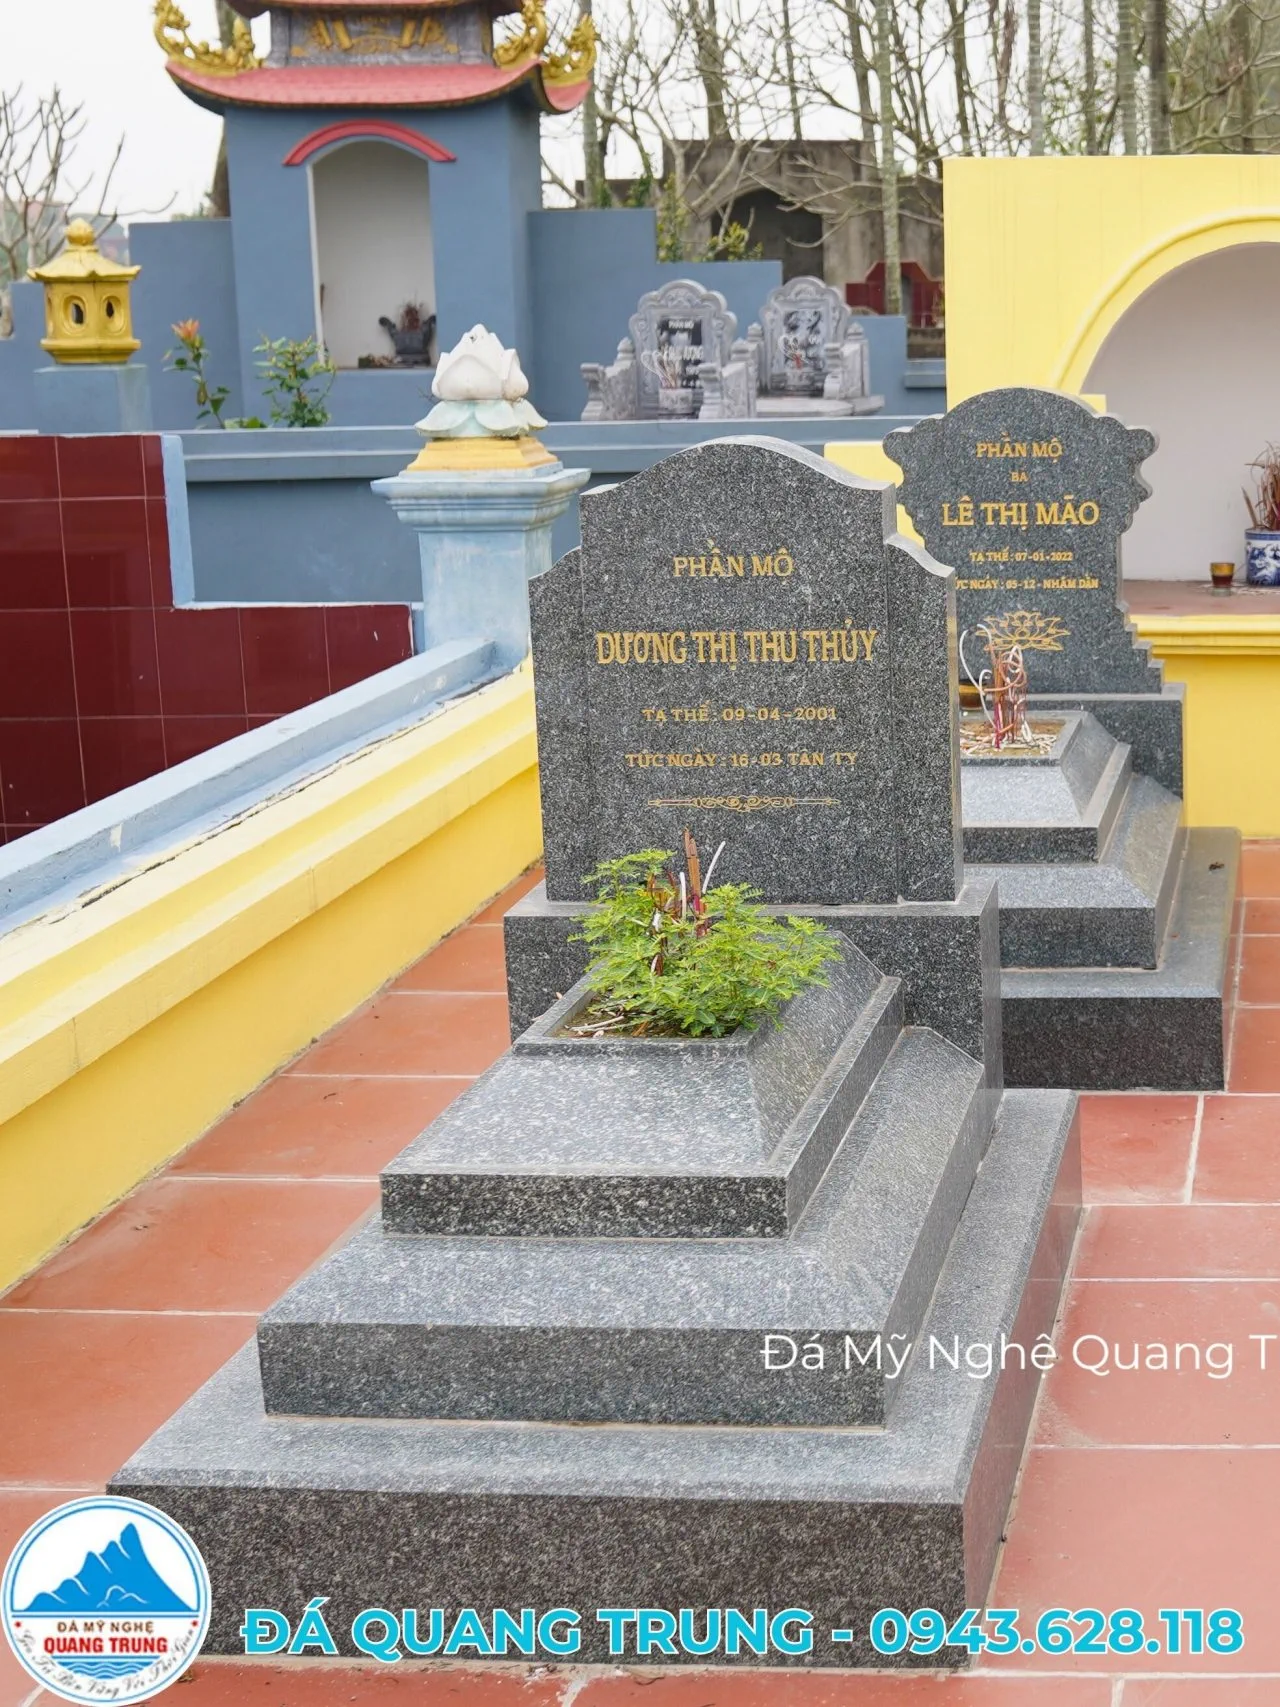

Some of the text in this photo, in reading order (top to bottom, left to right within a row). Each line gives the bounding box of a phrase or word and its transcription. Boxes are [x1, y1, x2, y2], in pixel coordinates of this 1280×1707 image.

[976, 431, 1064, 464] PHẦN MỘ
[942, 495, 1100, 531] LÊ THỊ MÃO
[673, 537, 794, 585] PHẦN MỘ
[970, 552, 985, 565] TẠ
[595, 631, 688, 665] DƯƠNG
[691, 631, 738, 671] THỊ
[744, 630, 798, 663] THU
[641, 709, 668, 727] TẠ
